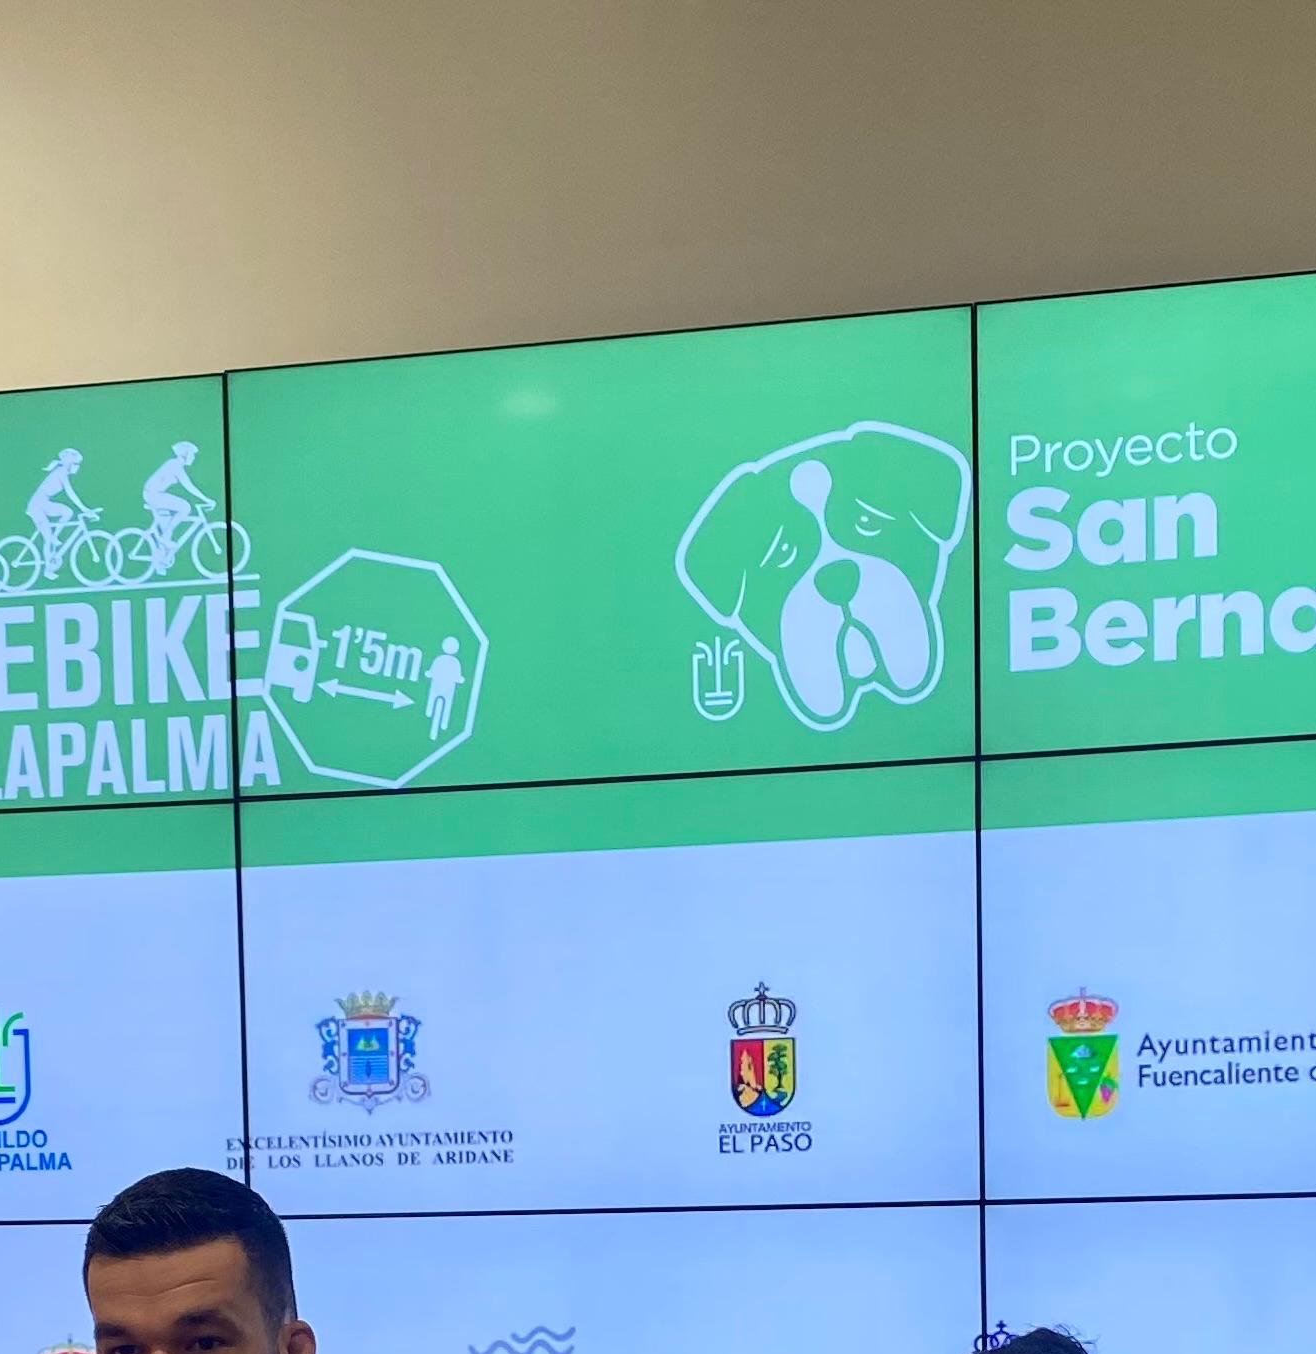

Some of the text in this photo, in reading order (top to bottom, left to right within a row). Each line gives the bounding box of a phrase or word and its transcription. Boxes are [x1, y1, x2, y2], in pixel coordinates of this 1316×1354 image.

[1011, 421, 1239, 479] Proyecto
[1004, 486, 1218, 572] San
[1138, 1061, 1300, 1088] Fuencaliente
[719, 1121, 812, 1134] AYUNTAMIENTO
[376, 1130, 513, 1147] AYUNTAMIENTO
[719, 1133, 812, 1153] EL PASO
[268, 1154, 301, 1170] LOS
[315, 1152, 384, 1168] LLANOS
[397, 1151, 421, 1166] DE
[433, 1149, 514, 1165] ARIDANE
